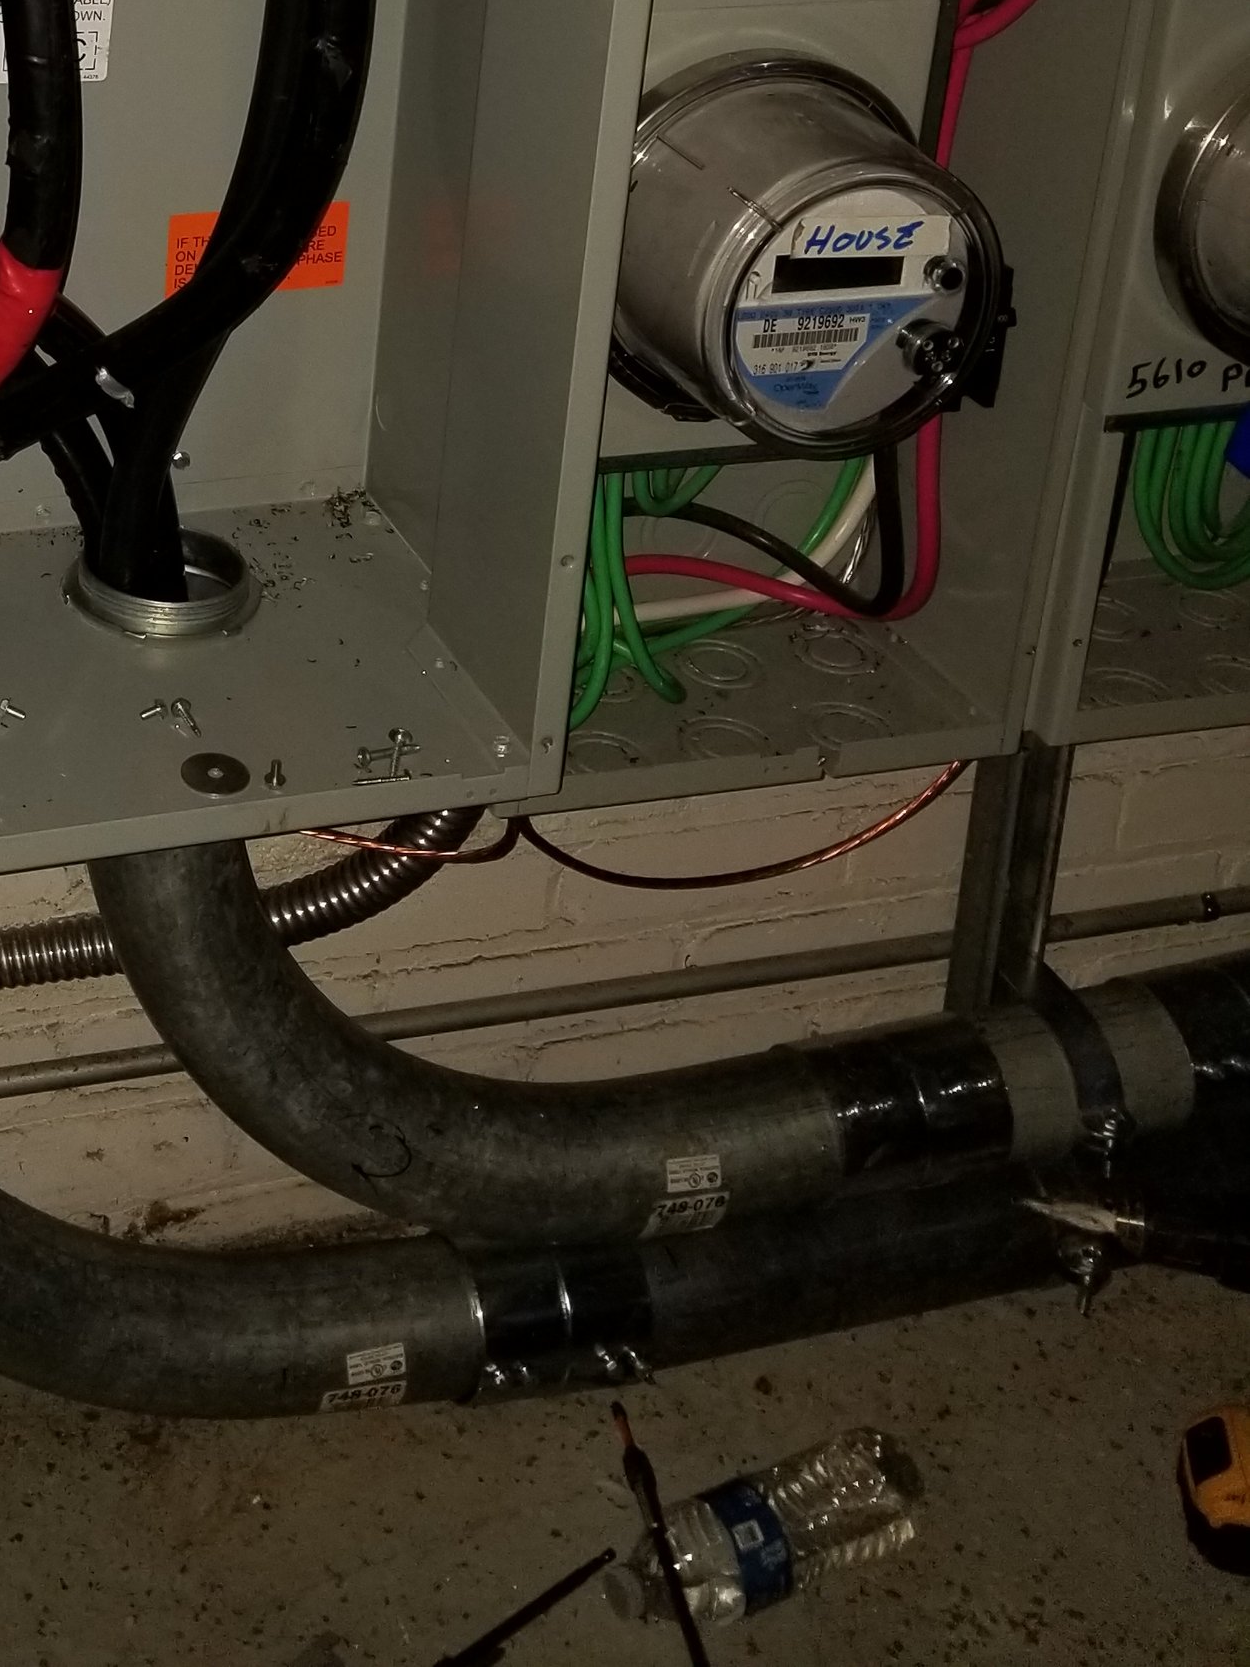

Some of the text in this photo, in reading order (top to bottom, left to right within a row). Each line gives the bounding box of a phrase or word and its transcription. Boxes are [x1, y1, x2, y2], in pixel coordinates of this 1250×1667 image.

[71, 10, 106, 22] OWN.
[176, 237, 188, 249] IF
[803, 220, 924, 256] HOUSE
[175, 250, 196, 262] ON
[762, 318, 778, 333] DE
[797, 314, 846, 331] 9219692
[1125, 357, 1207, 399] 5610
